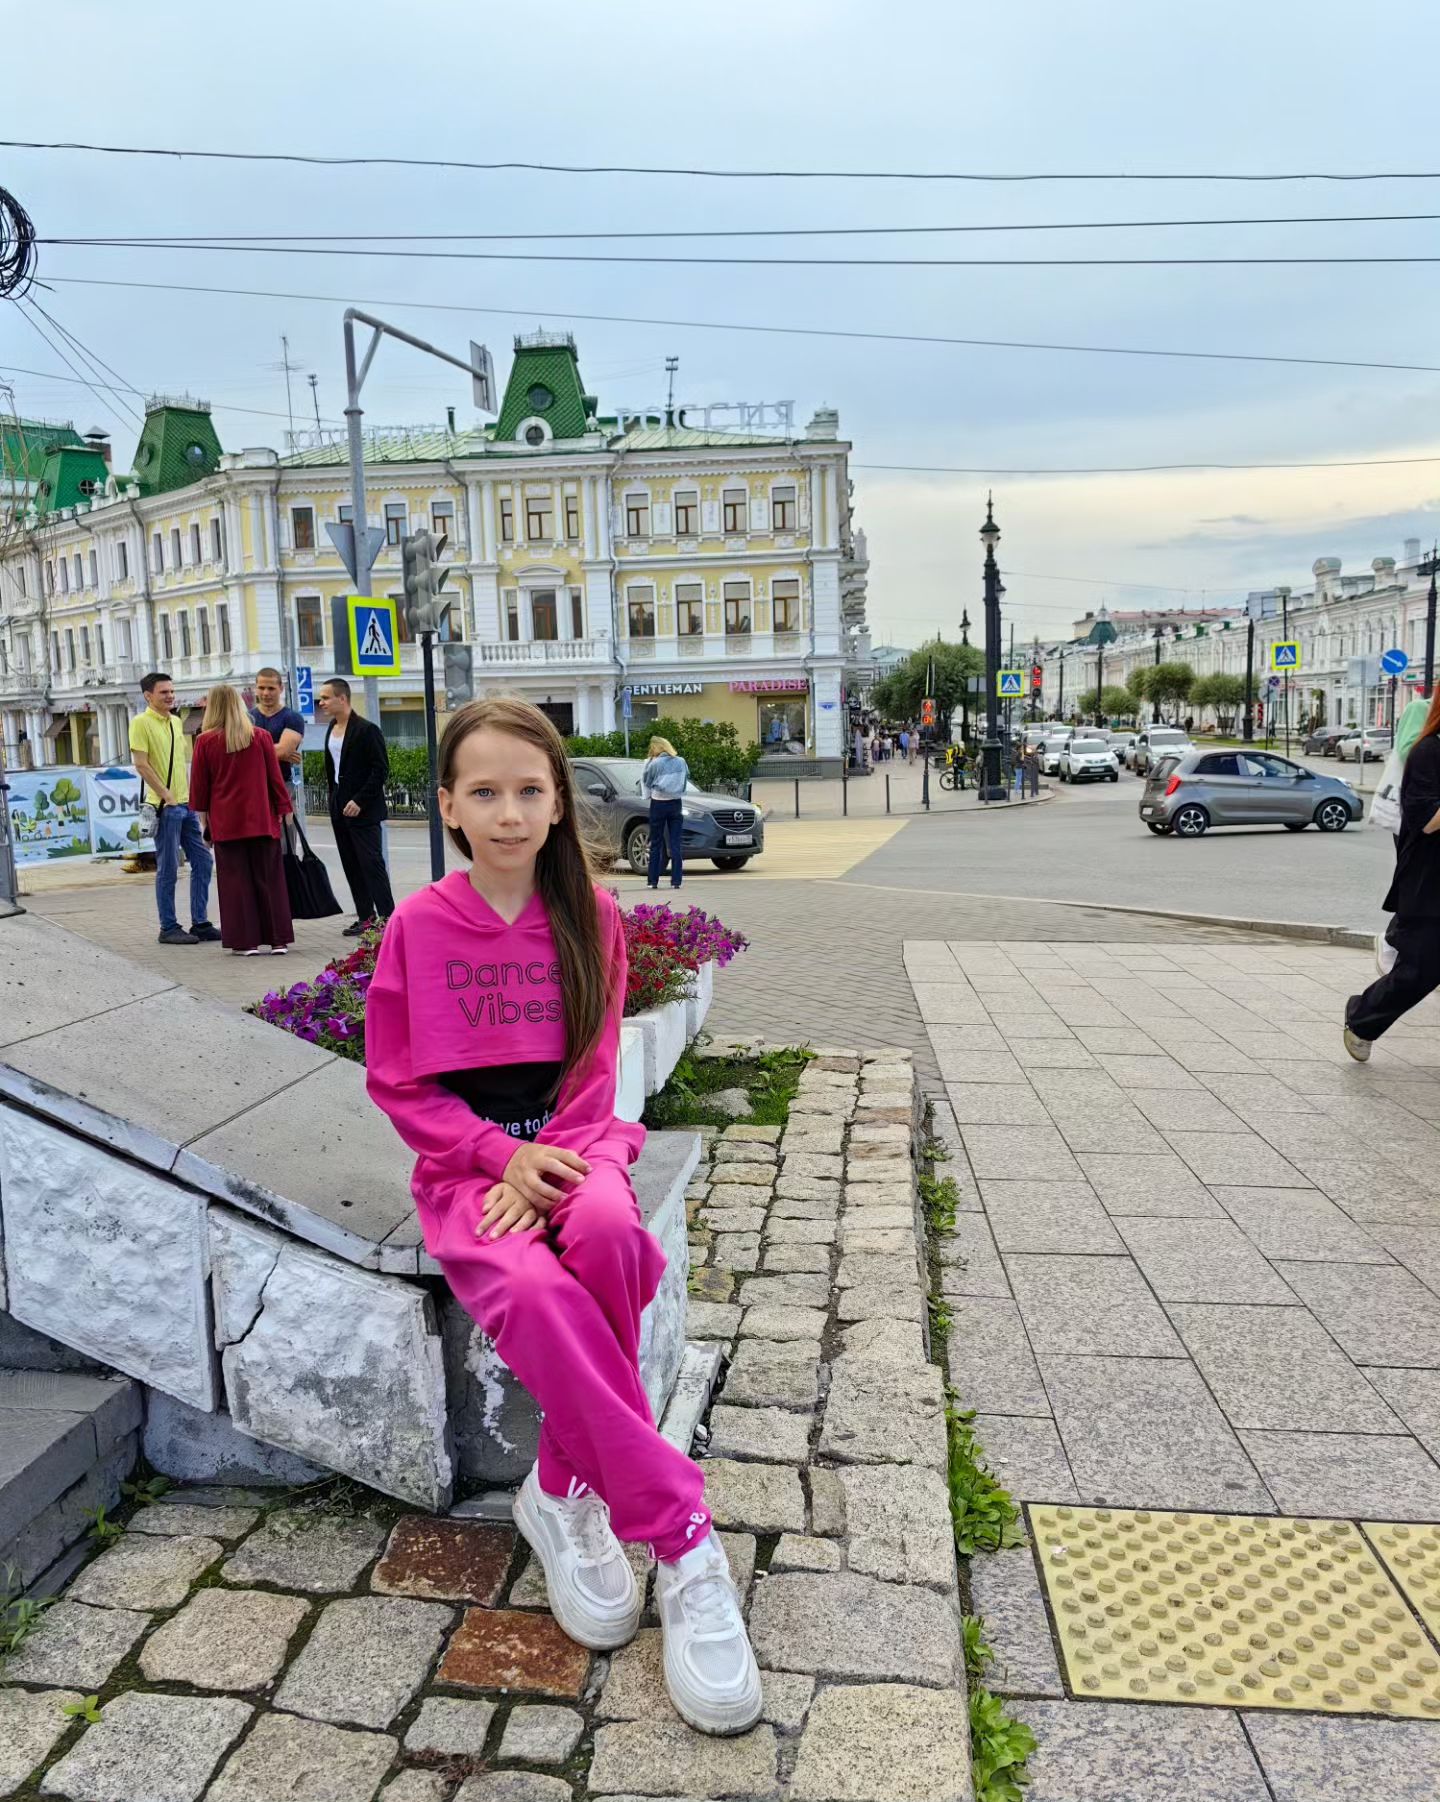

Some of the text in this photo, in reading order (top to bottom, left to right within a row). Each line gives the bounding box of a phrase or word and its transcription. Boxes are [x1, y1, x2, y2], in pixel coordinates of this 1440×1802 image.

[615, 400, 796, 435] РОССИЯ
[623, 683, 702, 696] GENTLEMAN
[729, 679, 807, 693] PARADISE
[446, 960, 561, 989] Dance
[458, 992, 561, 1027] Vibes
